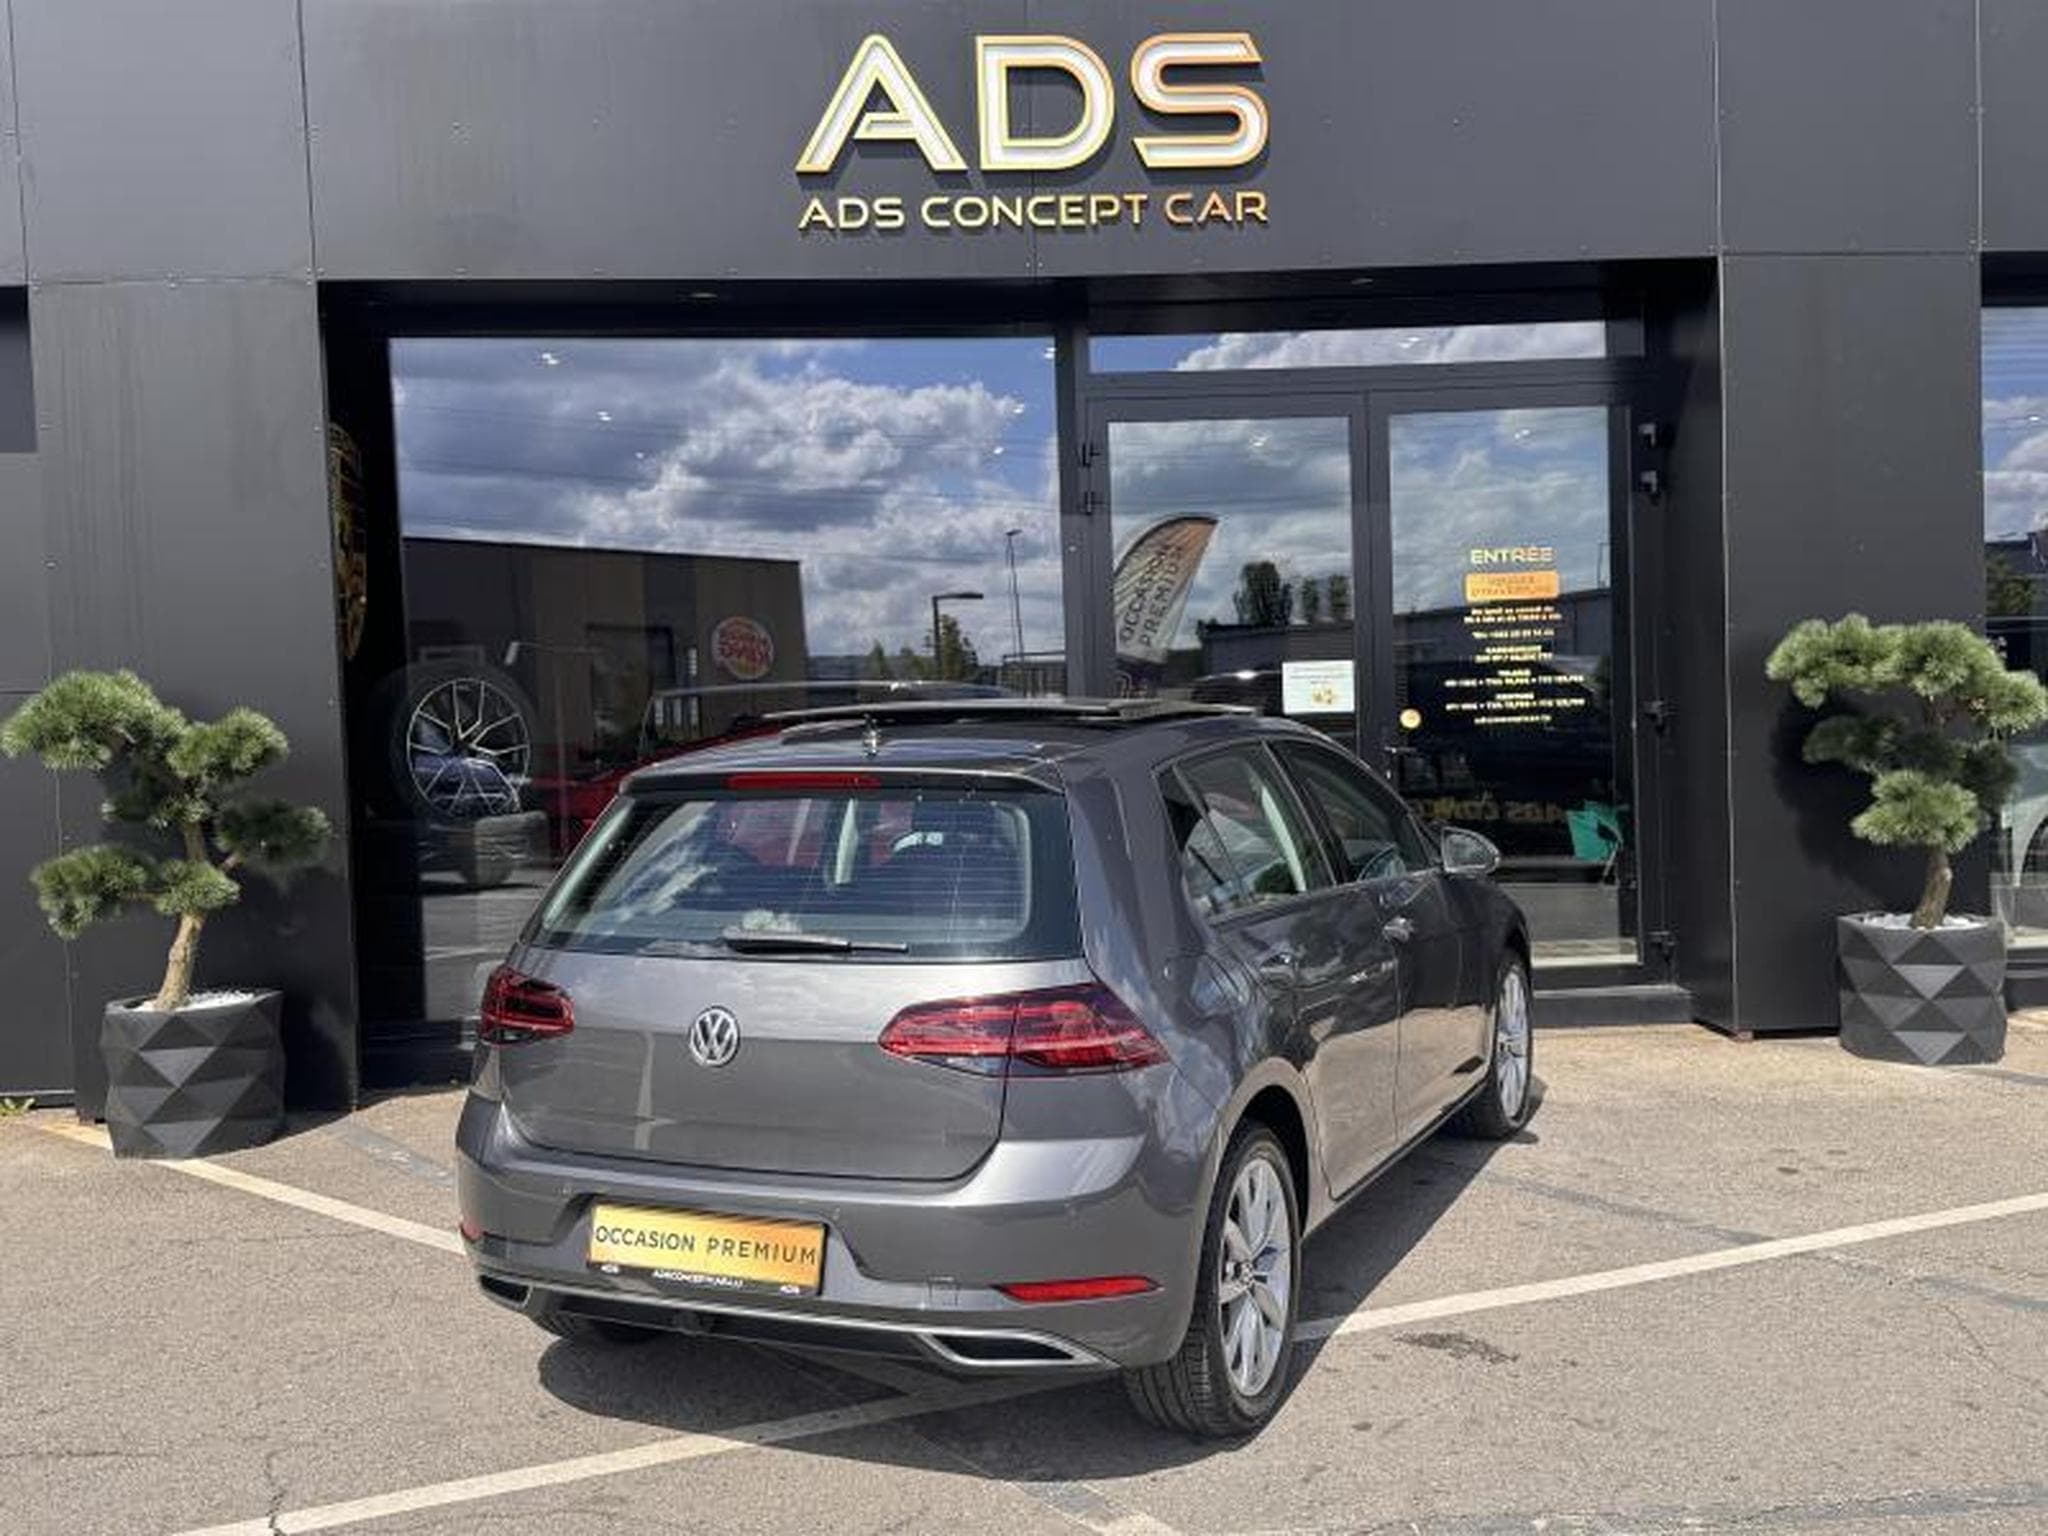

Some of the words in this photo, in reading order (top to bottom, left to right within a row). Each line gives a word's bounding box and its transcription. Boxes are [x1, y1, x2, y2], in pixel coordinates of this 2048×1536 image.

[795, 33, 1269, 172] ADS
[799, 197, 905, 229] ADS
[920, 194, 1148, 229] CONCEPT
[1165, 191, 1269, 225] CAR
[595, 1225, 696, 1252] OCCASION
[707, 1237, 815, 1266] PREMIUM
